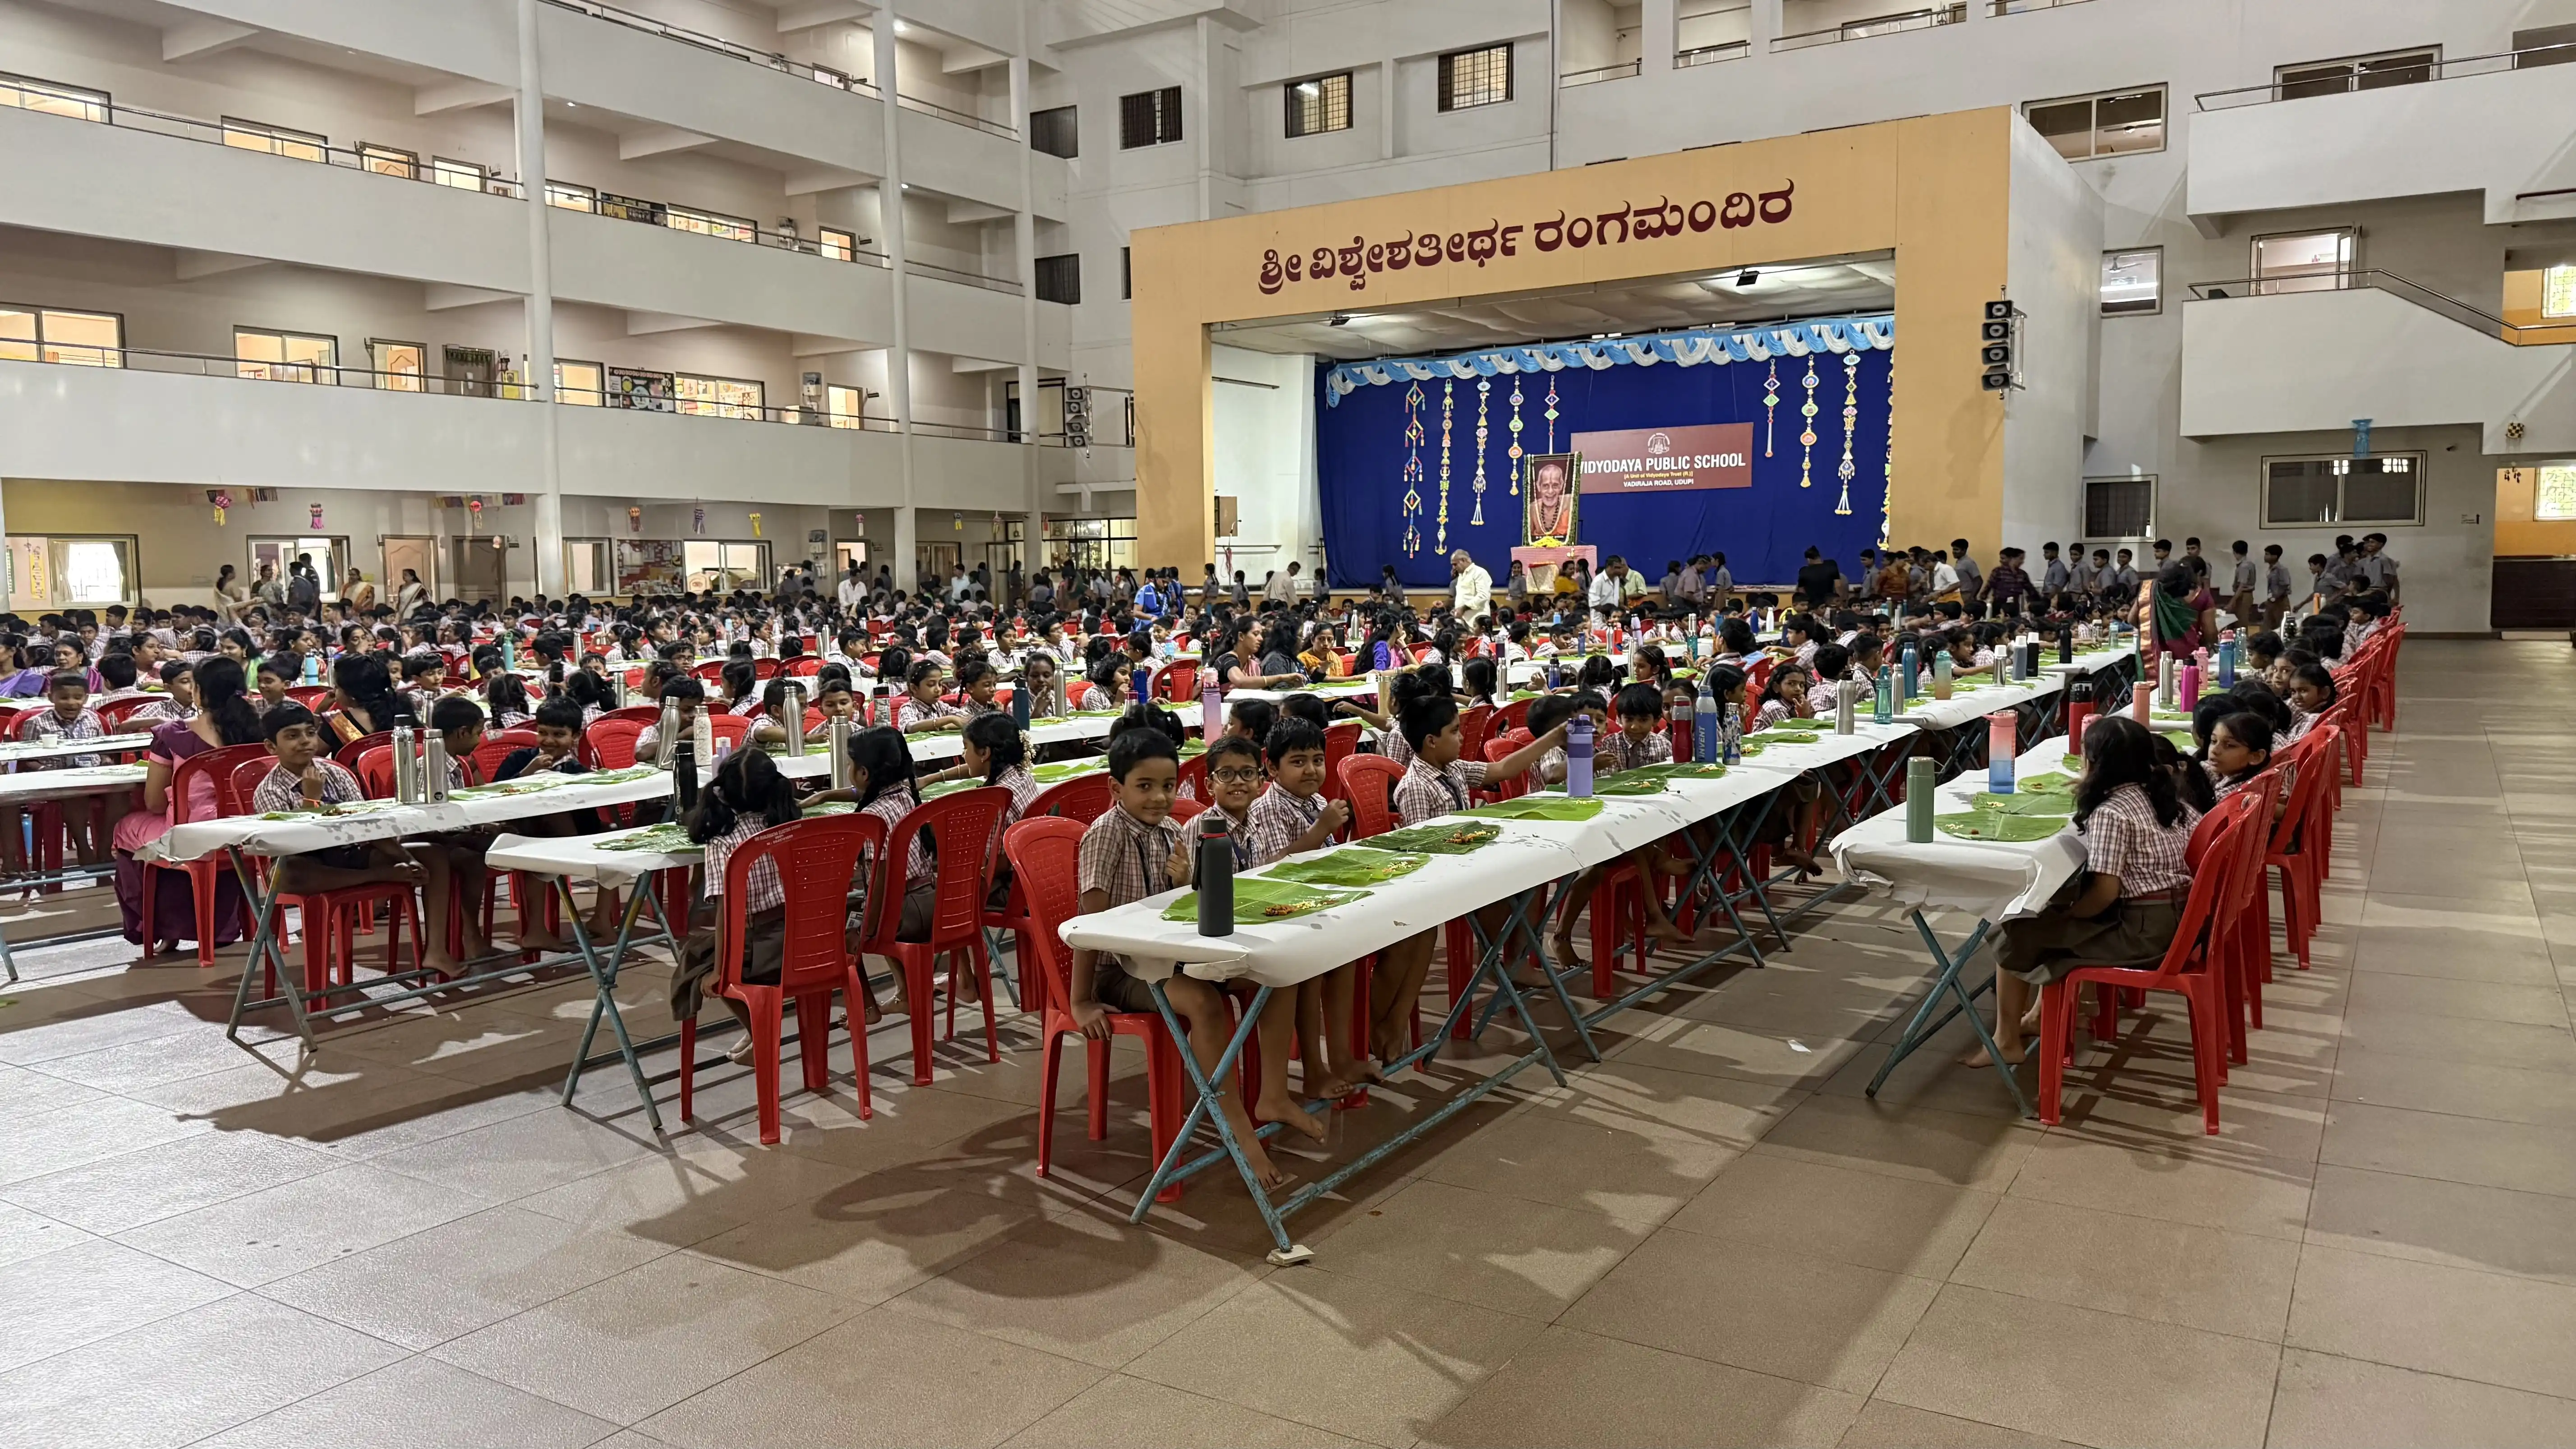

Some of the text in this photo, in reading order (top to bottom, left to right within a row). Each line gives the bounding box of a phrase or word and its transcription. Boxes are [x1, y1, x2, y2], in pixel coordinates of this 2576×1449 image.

[1258, 178, 1794, 295] ಶ್ರೀ ವಿಶ್ವೇಶತೀರ್ಥ ರಂಗಮಂದಿರ
[1646, 455, 1690, 471] PUBLIC
[1694, 453, 1746, 469] SCHOOL
